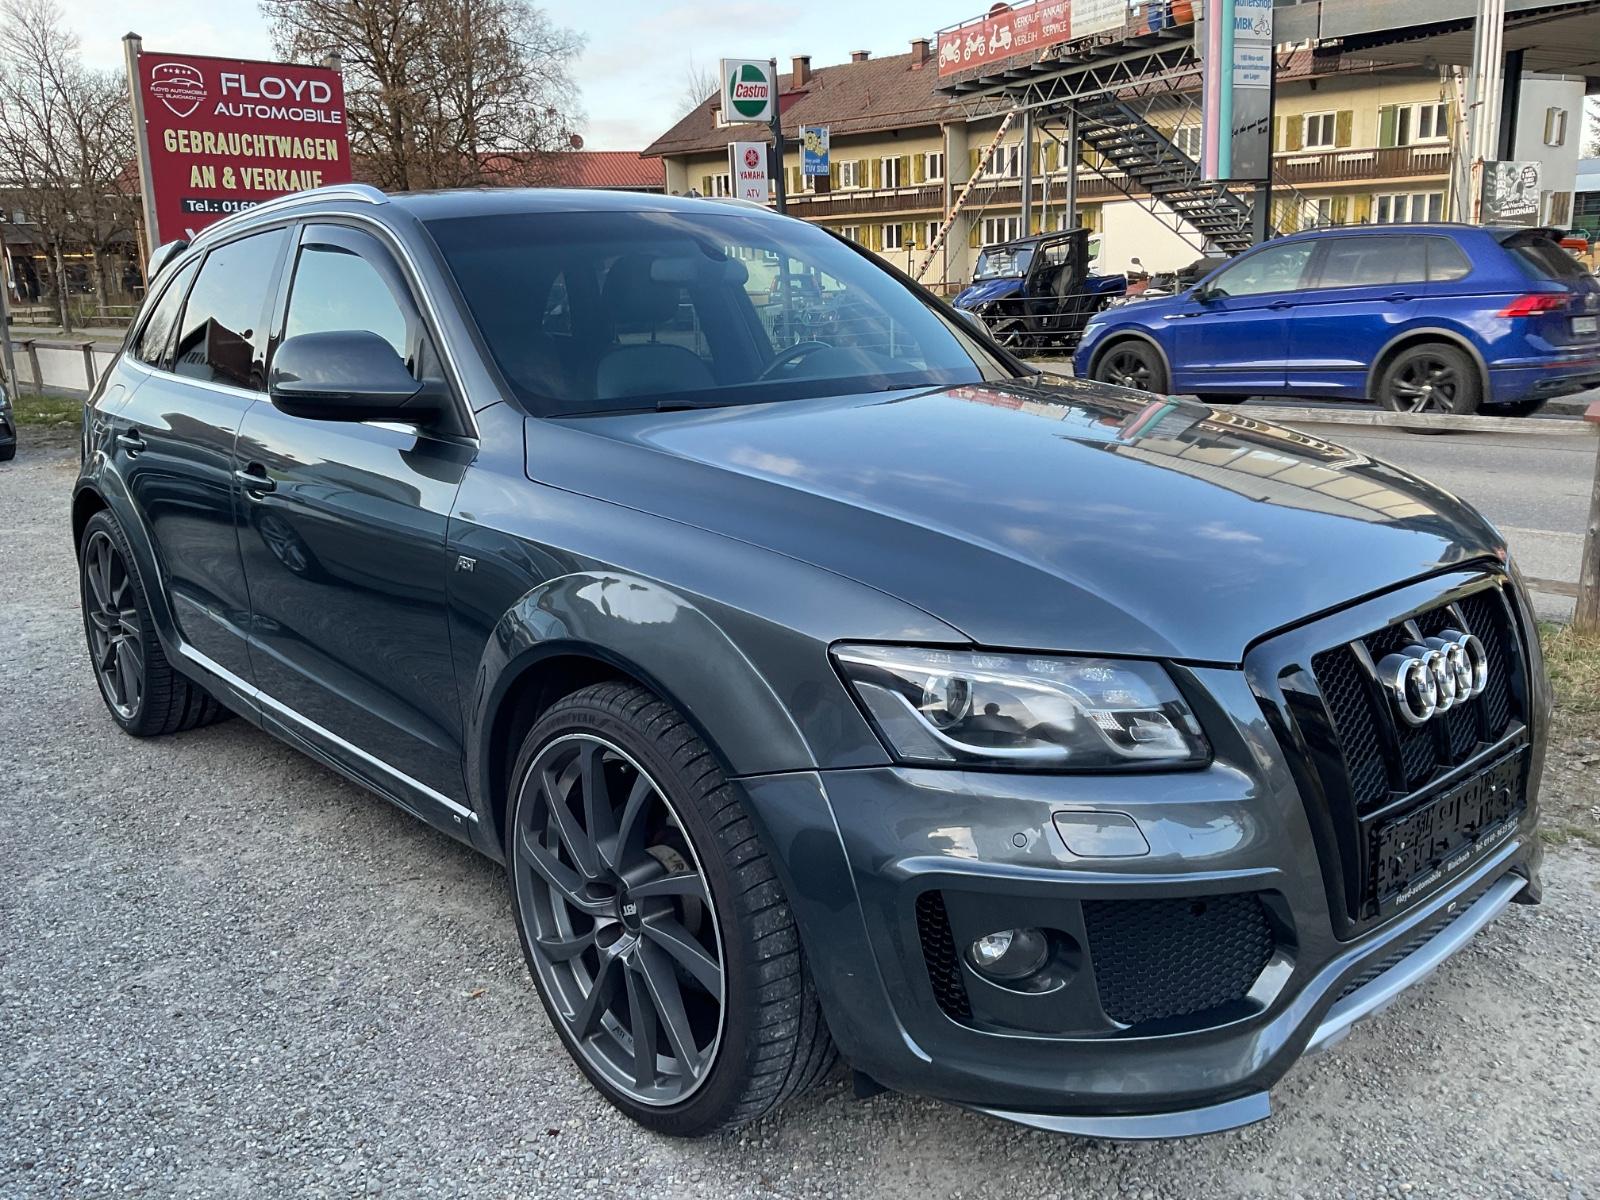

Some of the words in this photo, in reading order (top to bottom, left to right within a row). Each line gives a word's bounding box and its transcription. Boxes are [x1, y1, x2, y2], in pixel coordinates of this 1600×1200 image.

[1013, 11, 1040, 29] VERKAUF
[1043, 1, 1069, 18] ANKAUF
[1234, 17, 1253, 30] MBK
[1014, 31, 1037, 47] VERLEIH
[1042, 20, 1066, 37] SERVICE
[170, 88, 208, 96] AUTOMOBILE
[220, 72, 331, 104] FLOYD
[735, 83, 768, 98] Castrol
[214, 102, 342, 124] AUTOMOBILE
[163, 128, 339, 161] GEBRAUCHTWAGEN
[190, 165, 216, 189] AN
[222, 166, 236, 190] &
[240, 167, 323, 191] VERKAUF
[740, 171, 765, 180] YAMAHA
[746, 188, 760, 198] ATV
[187, 200, 218, 212] Tel.:
[1501, 206, 1536, 217] MILLIONÄR!
[623, 902, 637, 917] ABT
